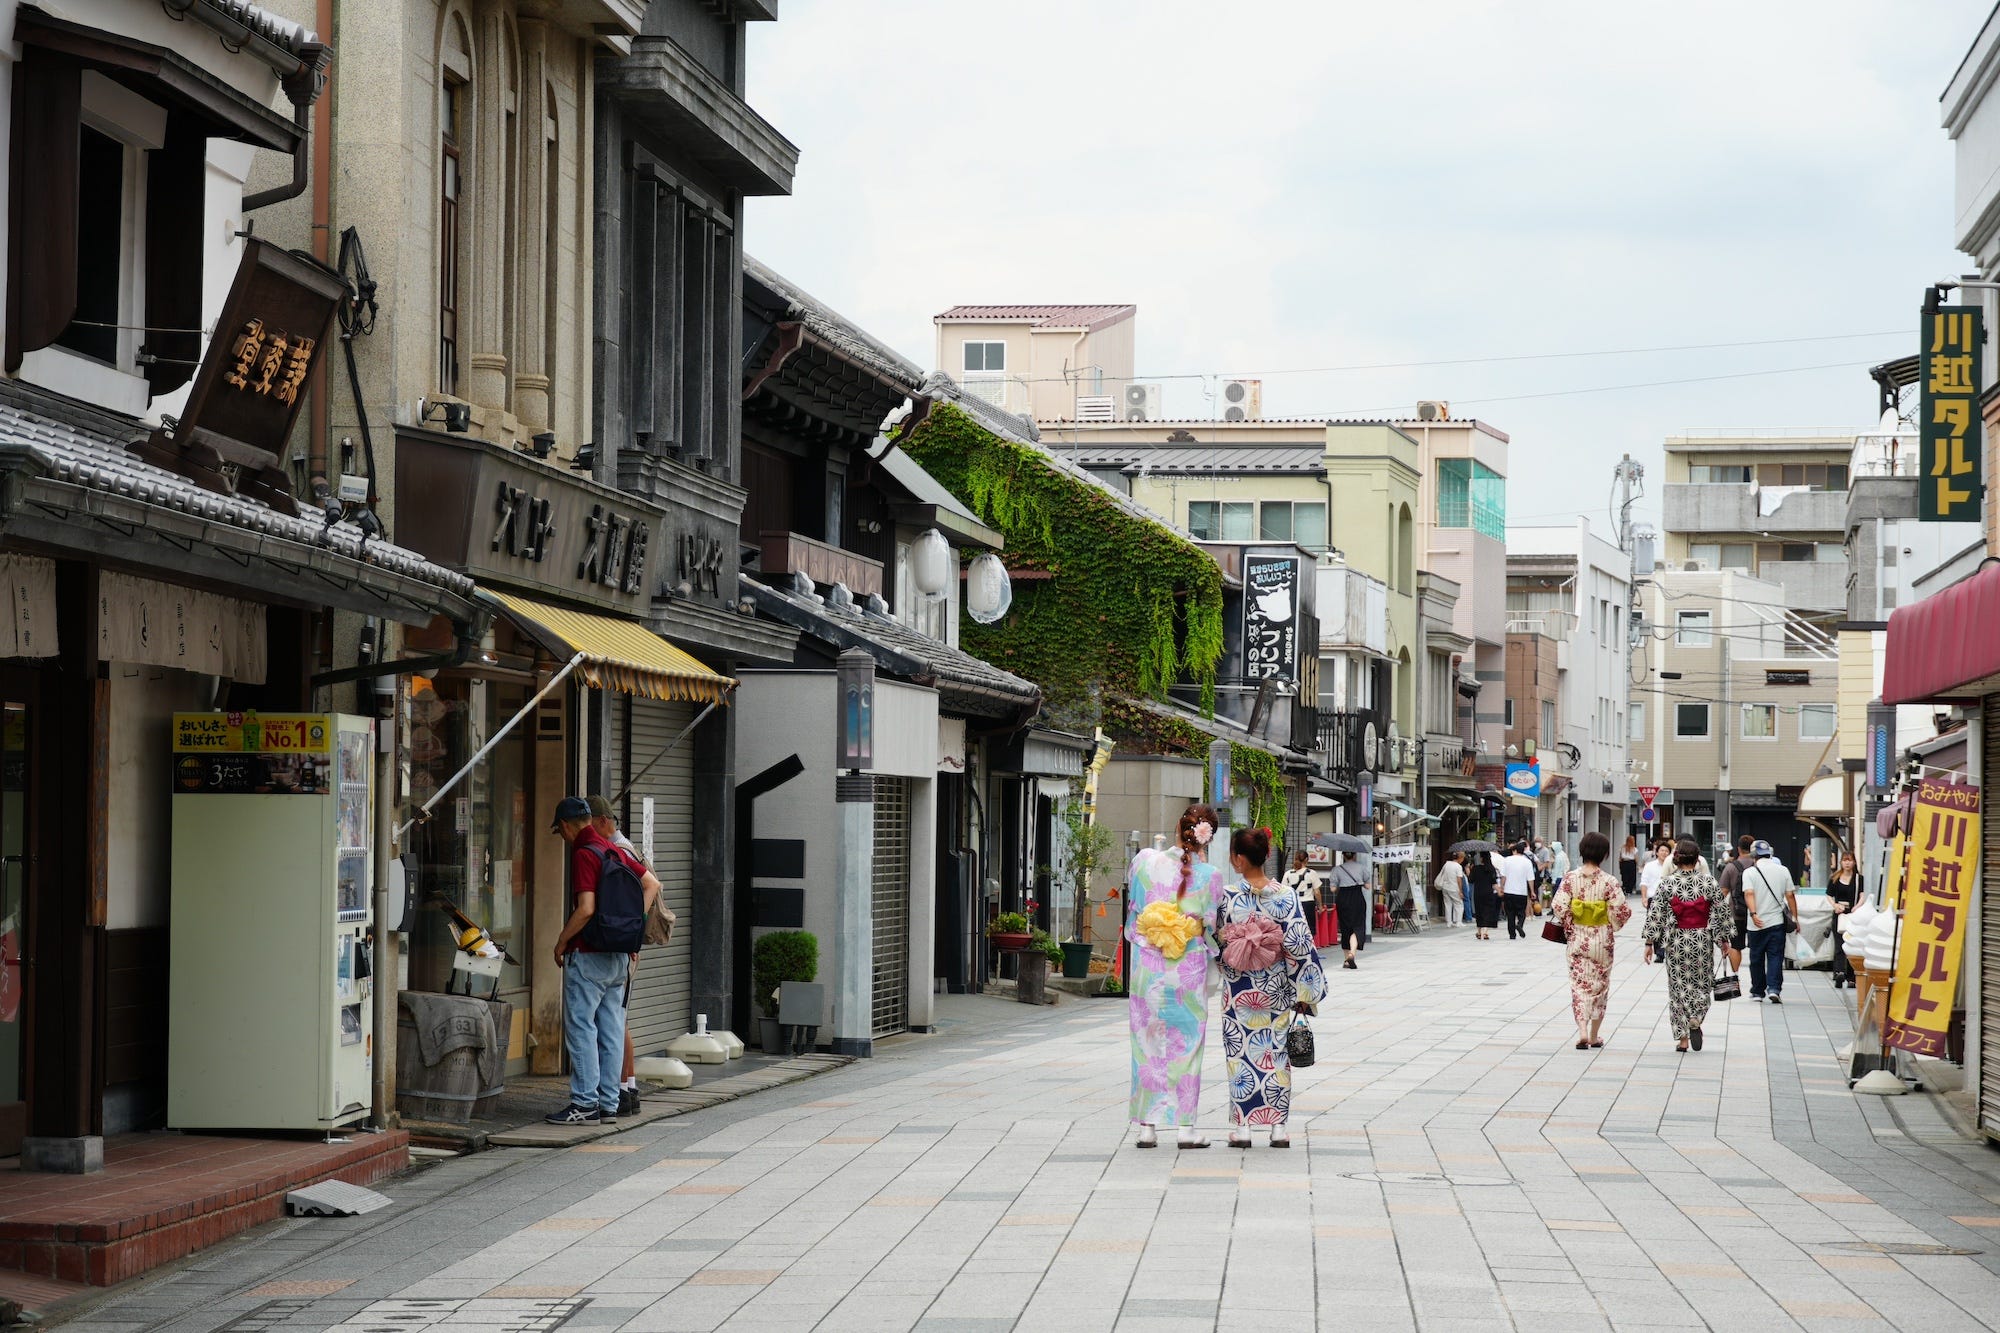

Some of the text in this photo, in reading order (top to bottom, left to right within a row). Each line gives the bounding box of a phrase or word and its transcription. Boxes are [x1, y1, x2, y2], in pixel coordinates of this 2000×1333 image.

[1928, 313, 1974, 516] 川越タルト
[1256, 570, 1296, 583] おいしいコーヒー
[179, 719, 227, 732] おいしさで
[265, 721, 307, 748] No.1
[1904, 811, 1968, 1021] 川越タルト
[1886, 1024, 1936, 1053] カフェ
